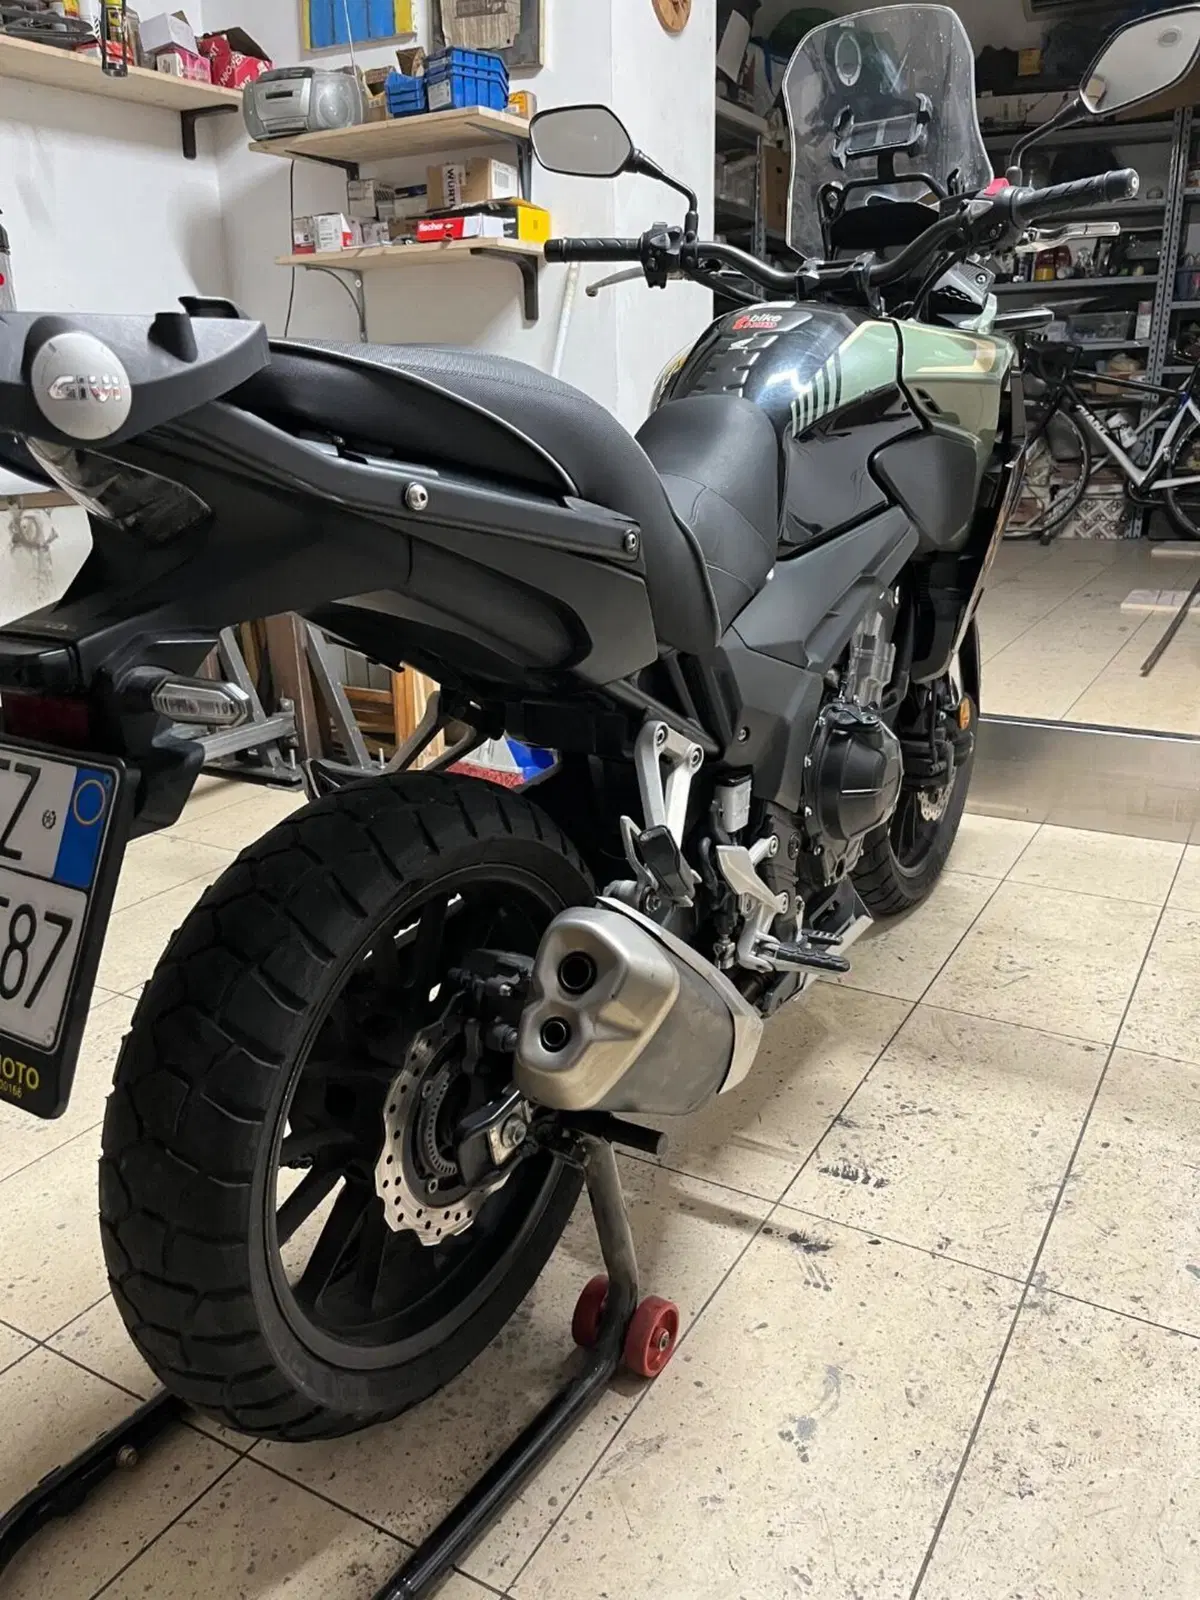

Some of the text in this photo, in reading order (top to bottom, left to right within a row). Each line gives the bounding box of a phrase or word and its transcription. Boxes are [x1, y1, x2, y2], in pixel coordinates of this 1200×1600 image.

[0, 758, 41, 860] Z
[0, 896, 73, 1009] 87
[0, 1053, 40, 1090] OTO
